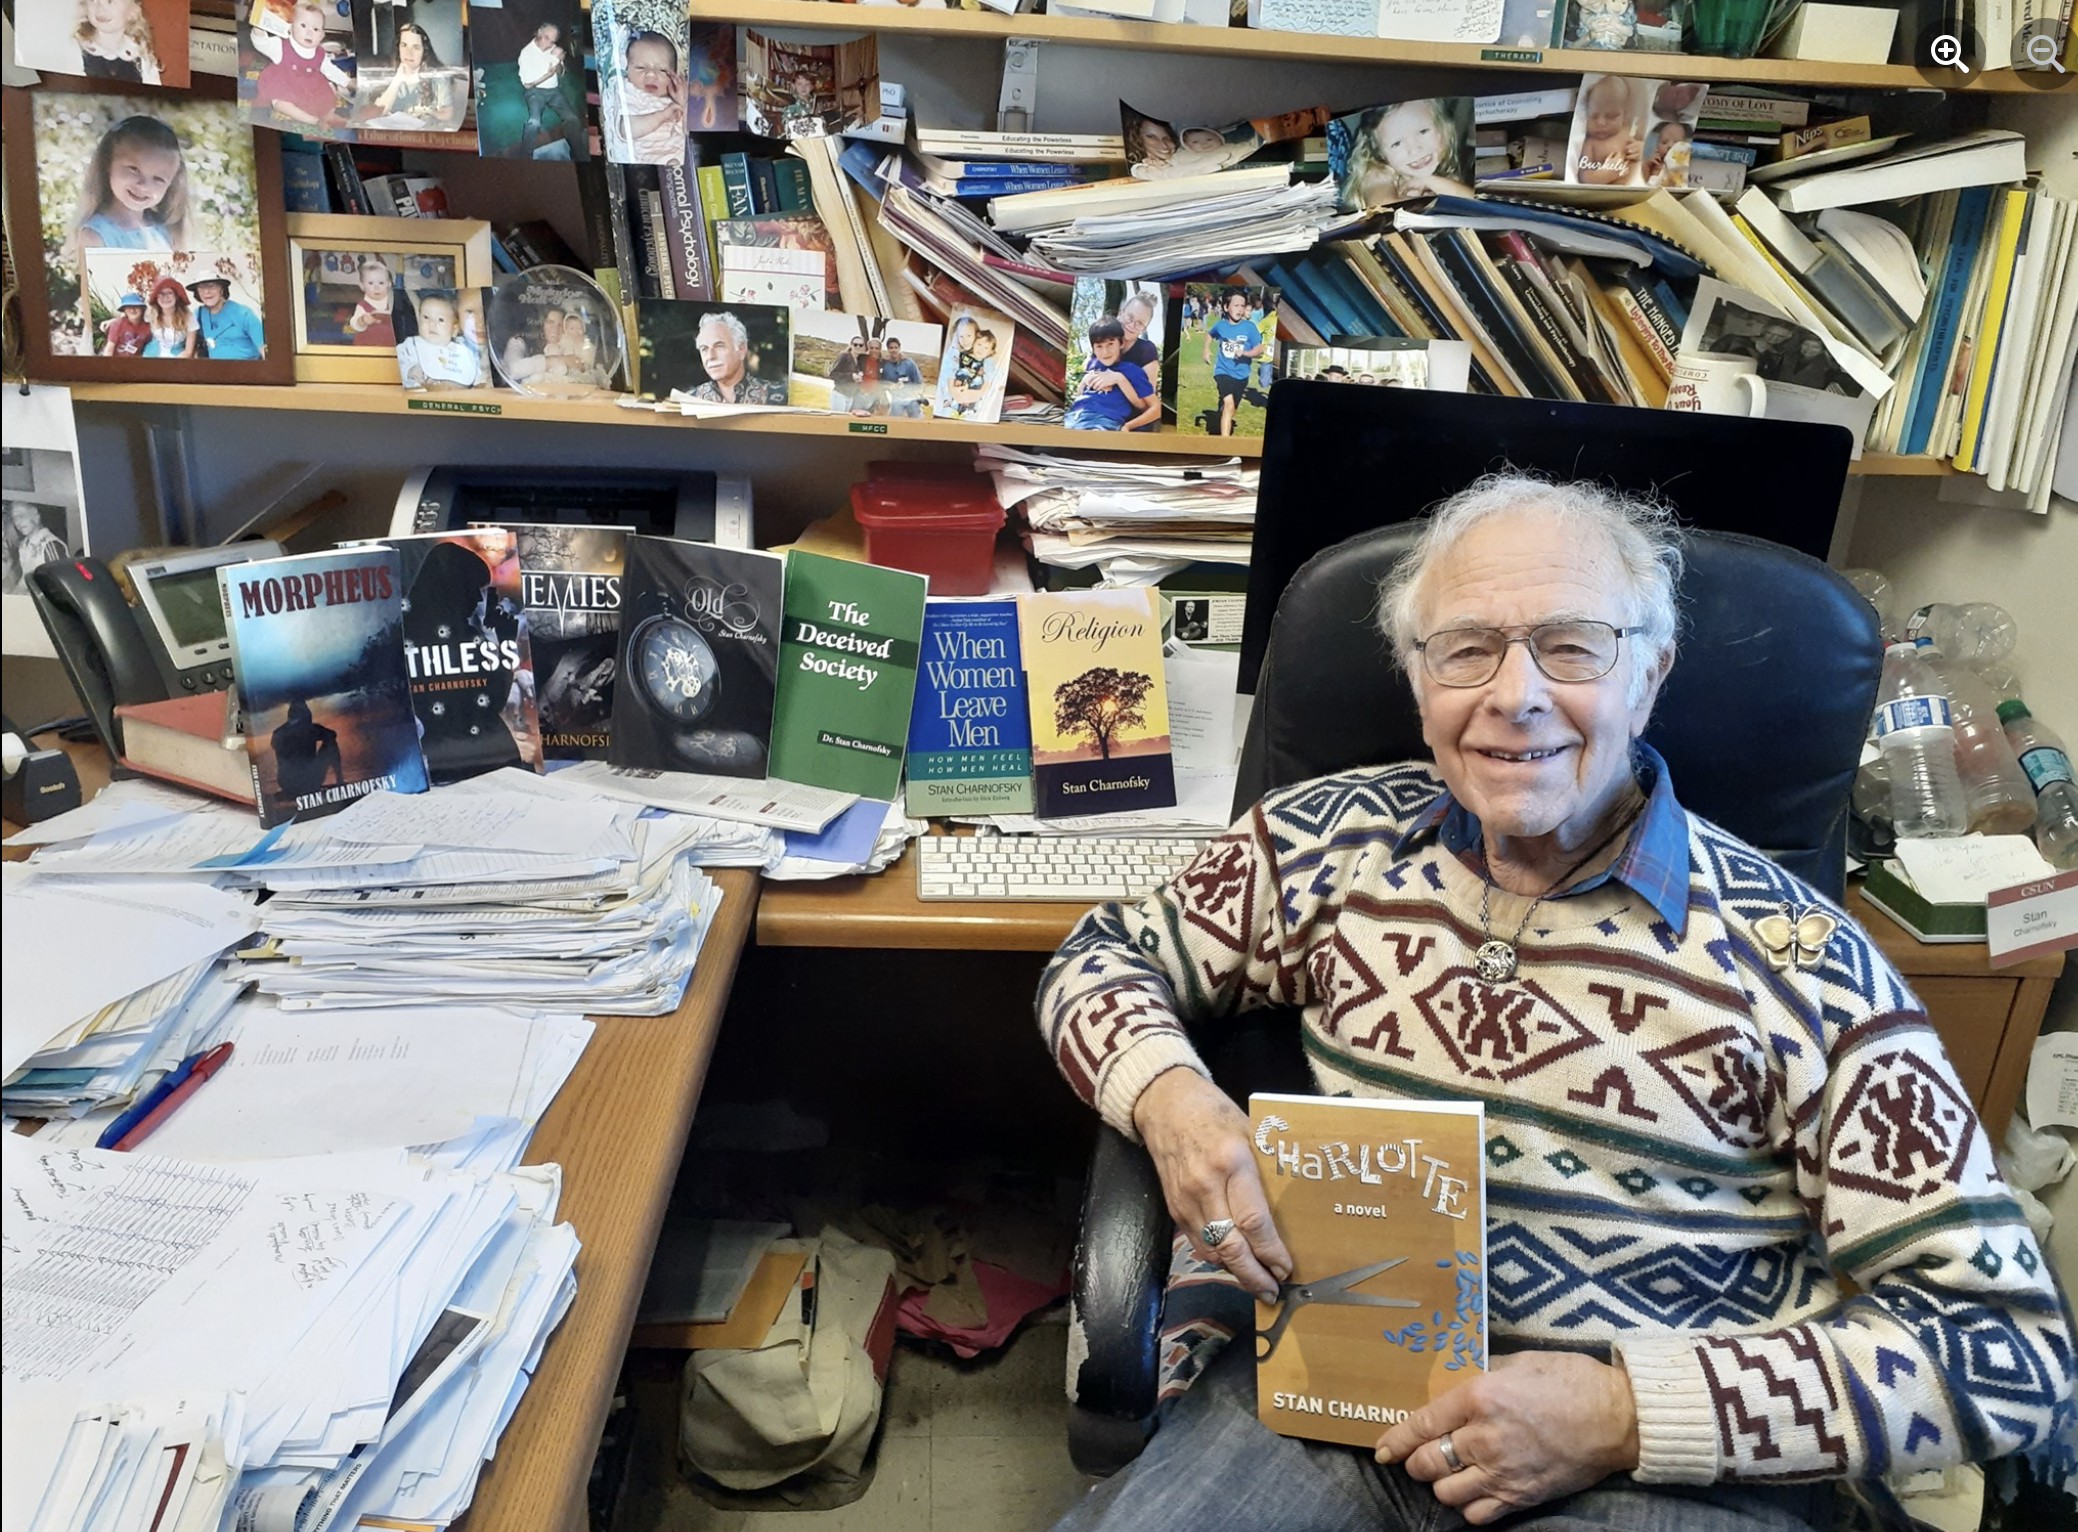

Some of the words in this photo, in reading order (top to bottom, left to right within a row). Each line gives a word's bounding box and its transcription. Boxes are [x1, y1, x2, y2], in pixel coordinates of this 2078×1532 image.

[1495, 52, 1536, 60] THERAPY
[1702, 98, 1729, 107] TOMY
[1732, 100, 1746, 108] OF
[1748, 100, 1775, 110] LOVE
[1002, 135, 1031, 143] Educating
[1795, 127, 1823, 149] Nips
[1005, 147, 1034, 155] Educating
[1010, 164, 1028, 174] When
[1028, 164, 1050, 174] Women
[1005, 181, 1023, 191] When
[1023, 181, 1047, 190] Women
[396, 196, 420, 218] PA
[672, 164, 687, 207] ormal
[680, 208, 700, 288] Psychology
[1625, 305, 1658, 343] Listening
[1632, 286, 1655, 310] THE
[1644, 305, 1679, 346] HANGED
[1542, 318, 1552, 330] and
[1548, 329, 1578, 368] Psychotherapy
[1649, 338, 1662, 351] To
[1654, 347, 1670, 364] The
[422, 401, 465, 412] GENERAL
[239, 565, 393, 618] MORPHEUS
[828, 600, 870, 626] The
[718, 629, 733, 639] Stan
[734, 630, 767, 645] Charnofsky
[796, 623, 894, 659] Deceived
[1042, 611, 1147, 653] Religion
[933, 631, 1006, 660] When
[404, 639, 520, 678] THLESS
[799, 652, 878, 690] Society
[925, 661, 1017, 689] Women
[409, 683, 425, 694] AN
[428, 678, 488, 692] CHARNOFSKY
[938, 690, 1007, 719] Leave
[541, 733, 610, 748] HARNOFS
[948, 719, 1000, 747] Men
[822, 733, 834, 744] Dr.
[835, 735, 851, 748] Stan
[852, 739, 892, 756] Charnofsky
[928, 756, 954, 764] HOW
[961, 754, 985, 762] MEN
[928, 766, 954, 774] HOW
[961, 765, 985, 773] MEN
[992, 764, 1022, 772] HEAL
[295, 790, 323, 811] STAN
[326, 774, 397, 803] CHARNOFSKY
[928, 784, 954, 796] STAN
[956, 783, 1022, 795] CHARNOFSKY
[1062, 781, 1087, 795] Stan
[1089, 775, 1151, 791] Charnofsky
[2021, 880, 2055, 897] CSUN
[2023, 910, 2048, 924] Stan
[1334, 1203, 1343, 1214] a
[1346, 1203, 1388, 1218] novel
[1273, 1391, 1324, 1416] STAN
[1327, 1399, 1416, 1427] CHARNO
[328, 1489, 343, 1507] THAT
[339, 1461, 362, 1490] MATTERS
